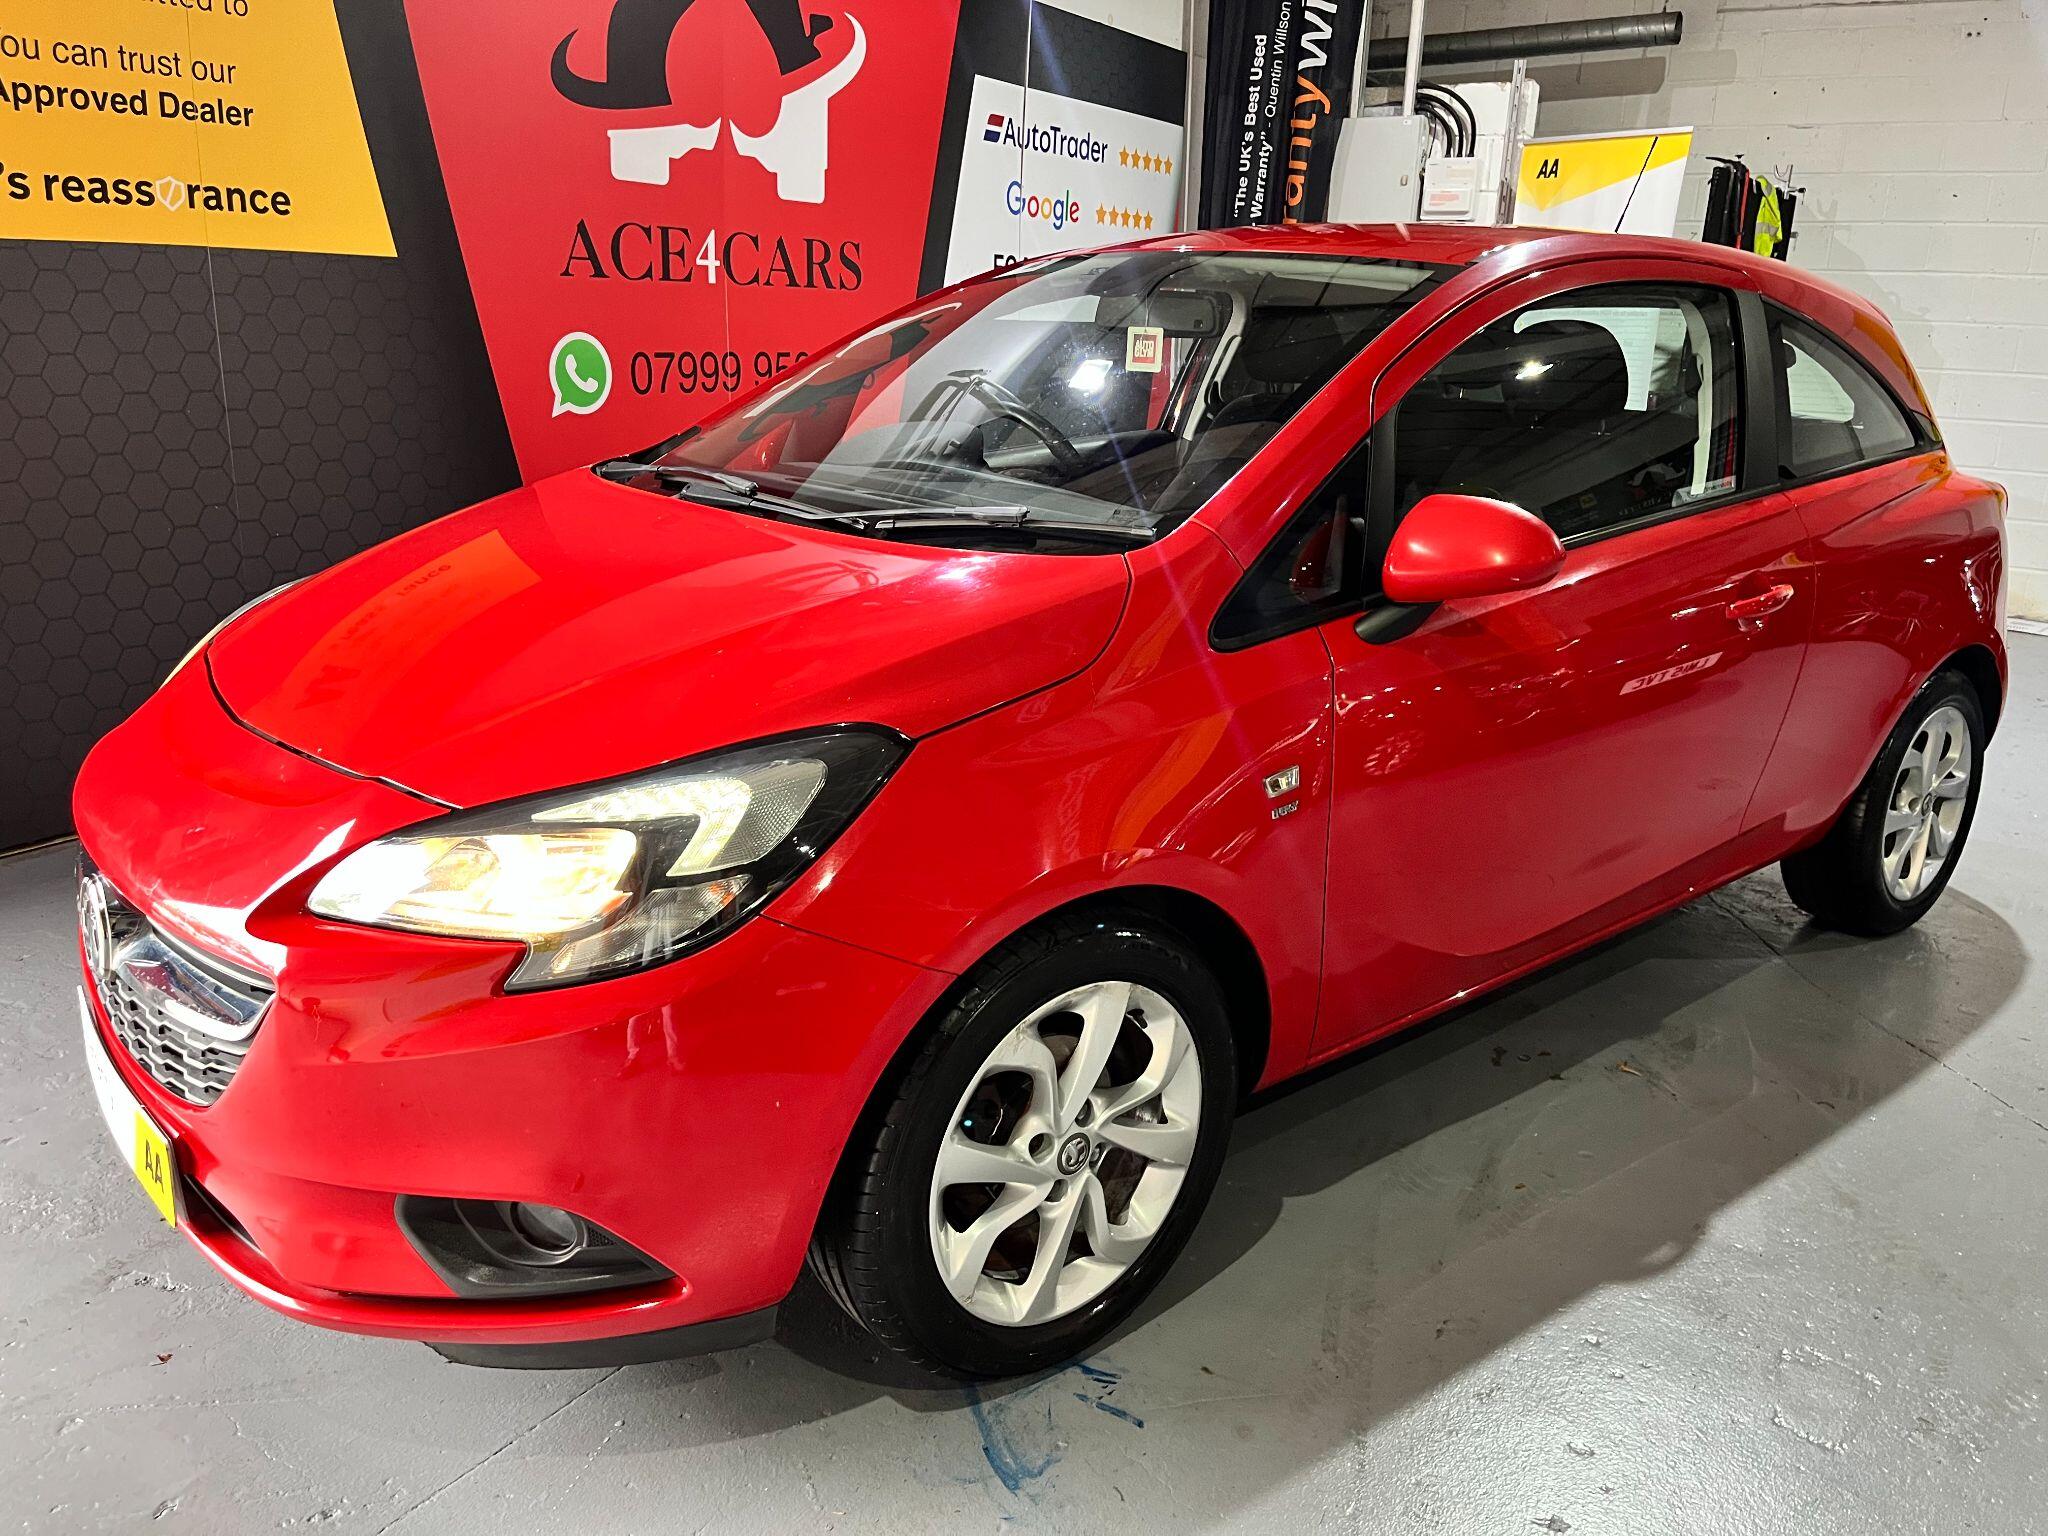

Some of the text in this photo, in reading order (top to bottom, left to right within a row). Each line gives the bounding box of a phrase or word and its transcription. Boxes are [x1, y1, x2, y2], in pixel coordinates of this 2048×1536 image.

[1273, 1, 1292, 55] Willson
[0, 34, 237, 84] ou can trust our
[1250, 34, 1268, 81] Used
[159, 91, 254, 127] Dealer
[1244, 86, 1260, 126] Best
[1264, 60, 1283, 117] Quentin
[1003, 117, 1108, 163] AutoTrader
[1537, 158, 1559, 179] AA
[1006, 180, 1080, 230] Google
[560, 218, 863, 291] ACE4CARS
[631, 351, 808, 395] 07999 95
[145, 1138, 164, 1195] AA
